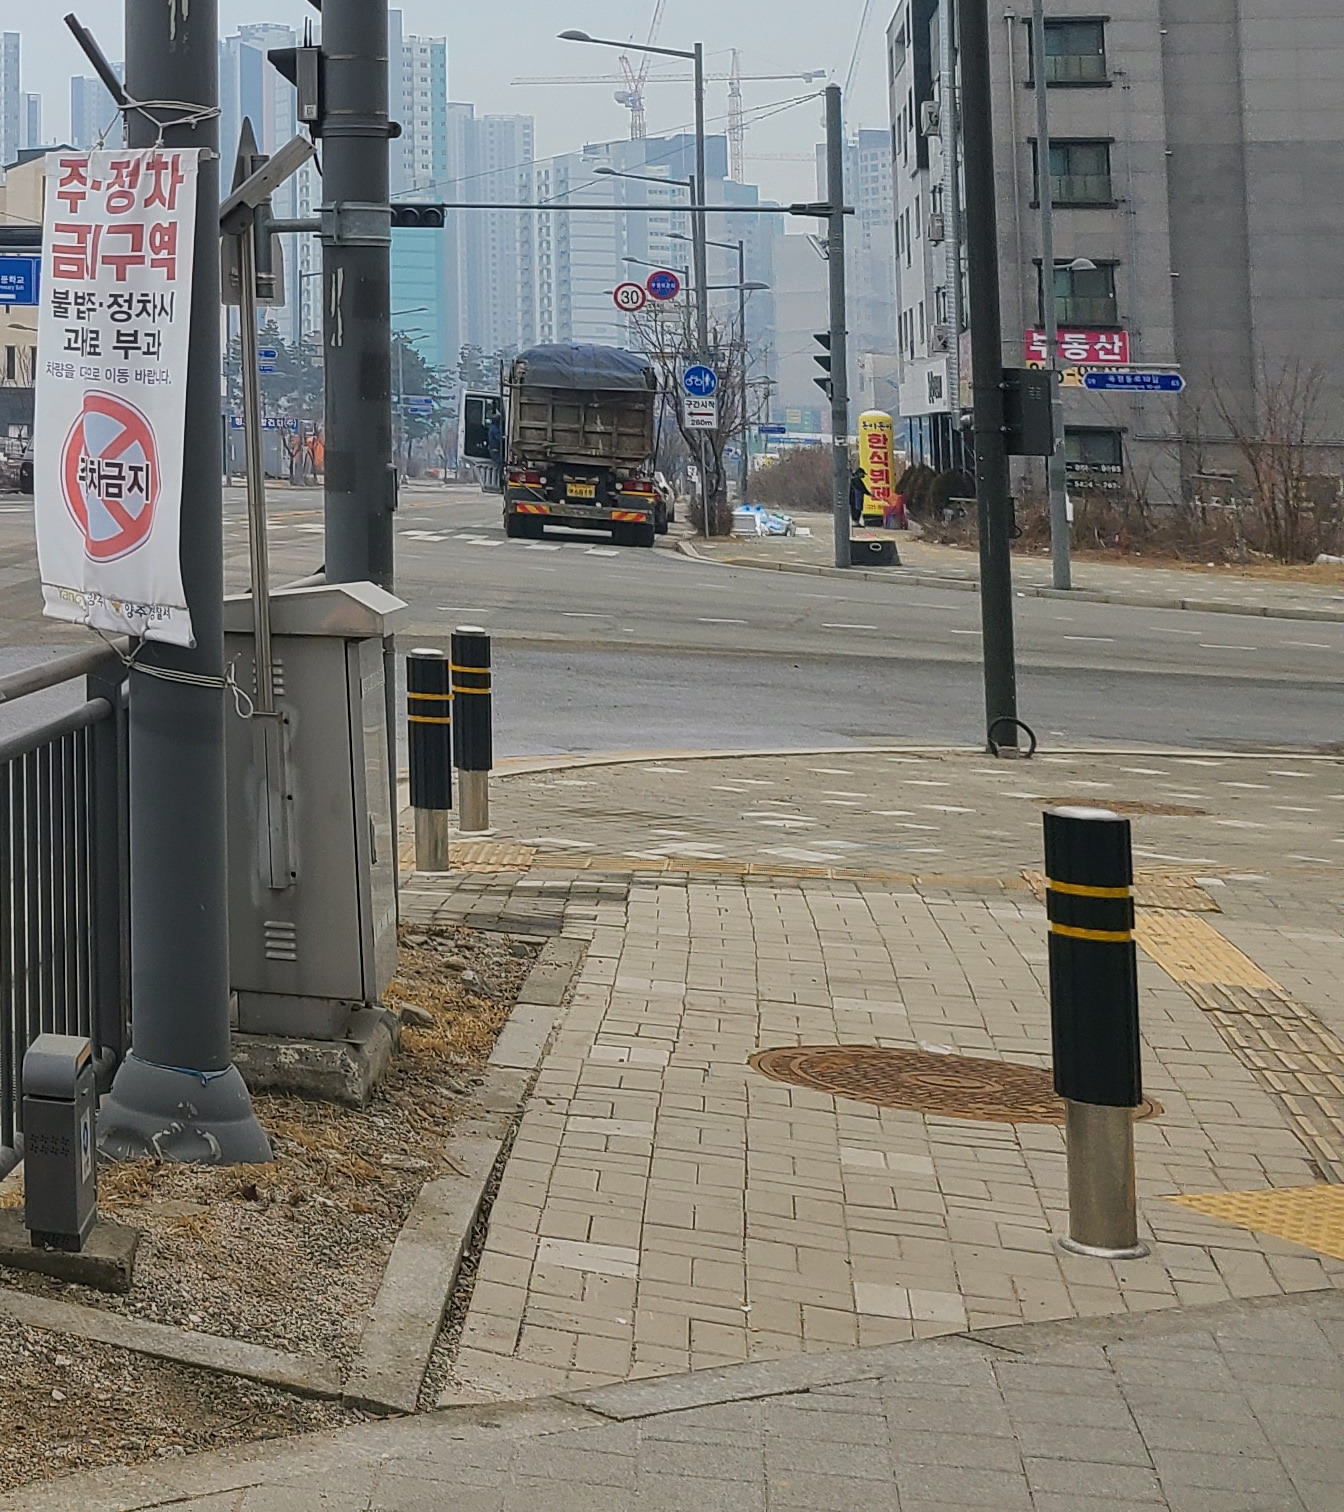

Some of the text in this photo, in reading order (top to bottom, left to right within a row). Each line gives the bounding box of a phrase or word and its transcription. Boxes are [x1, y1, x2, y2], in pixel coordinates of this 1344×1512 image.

[620, 290, 640, 304] 30
[112, 329, 162, 362] 부과
[105, 367, 130, 384] 이동
